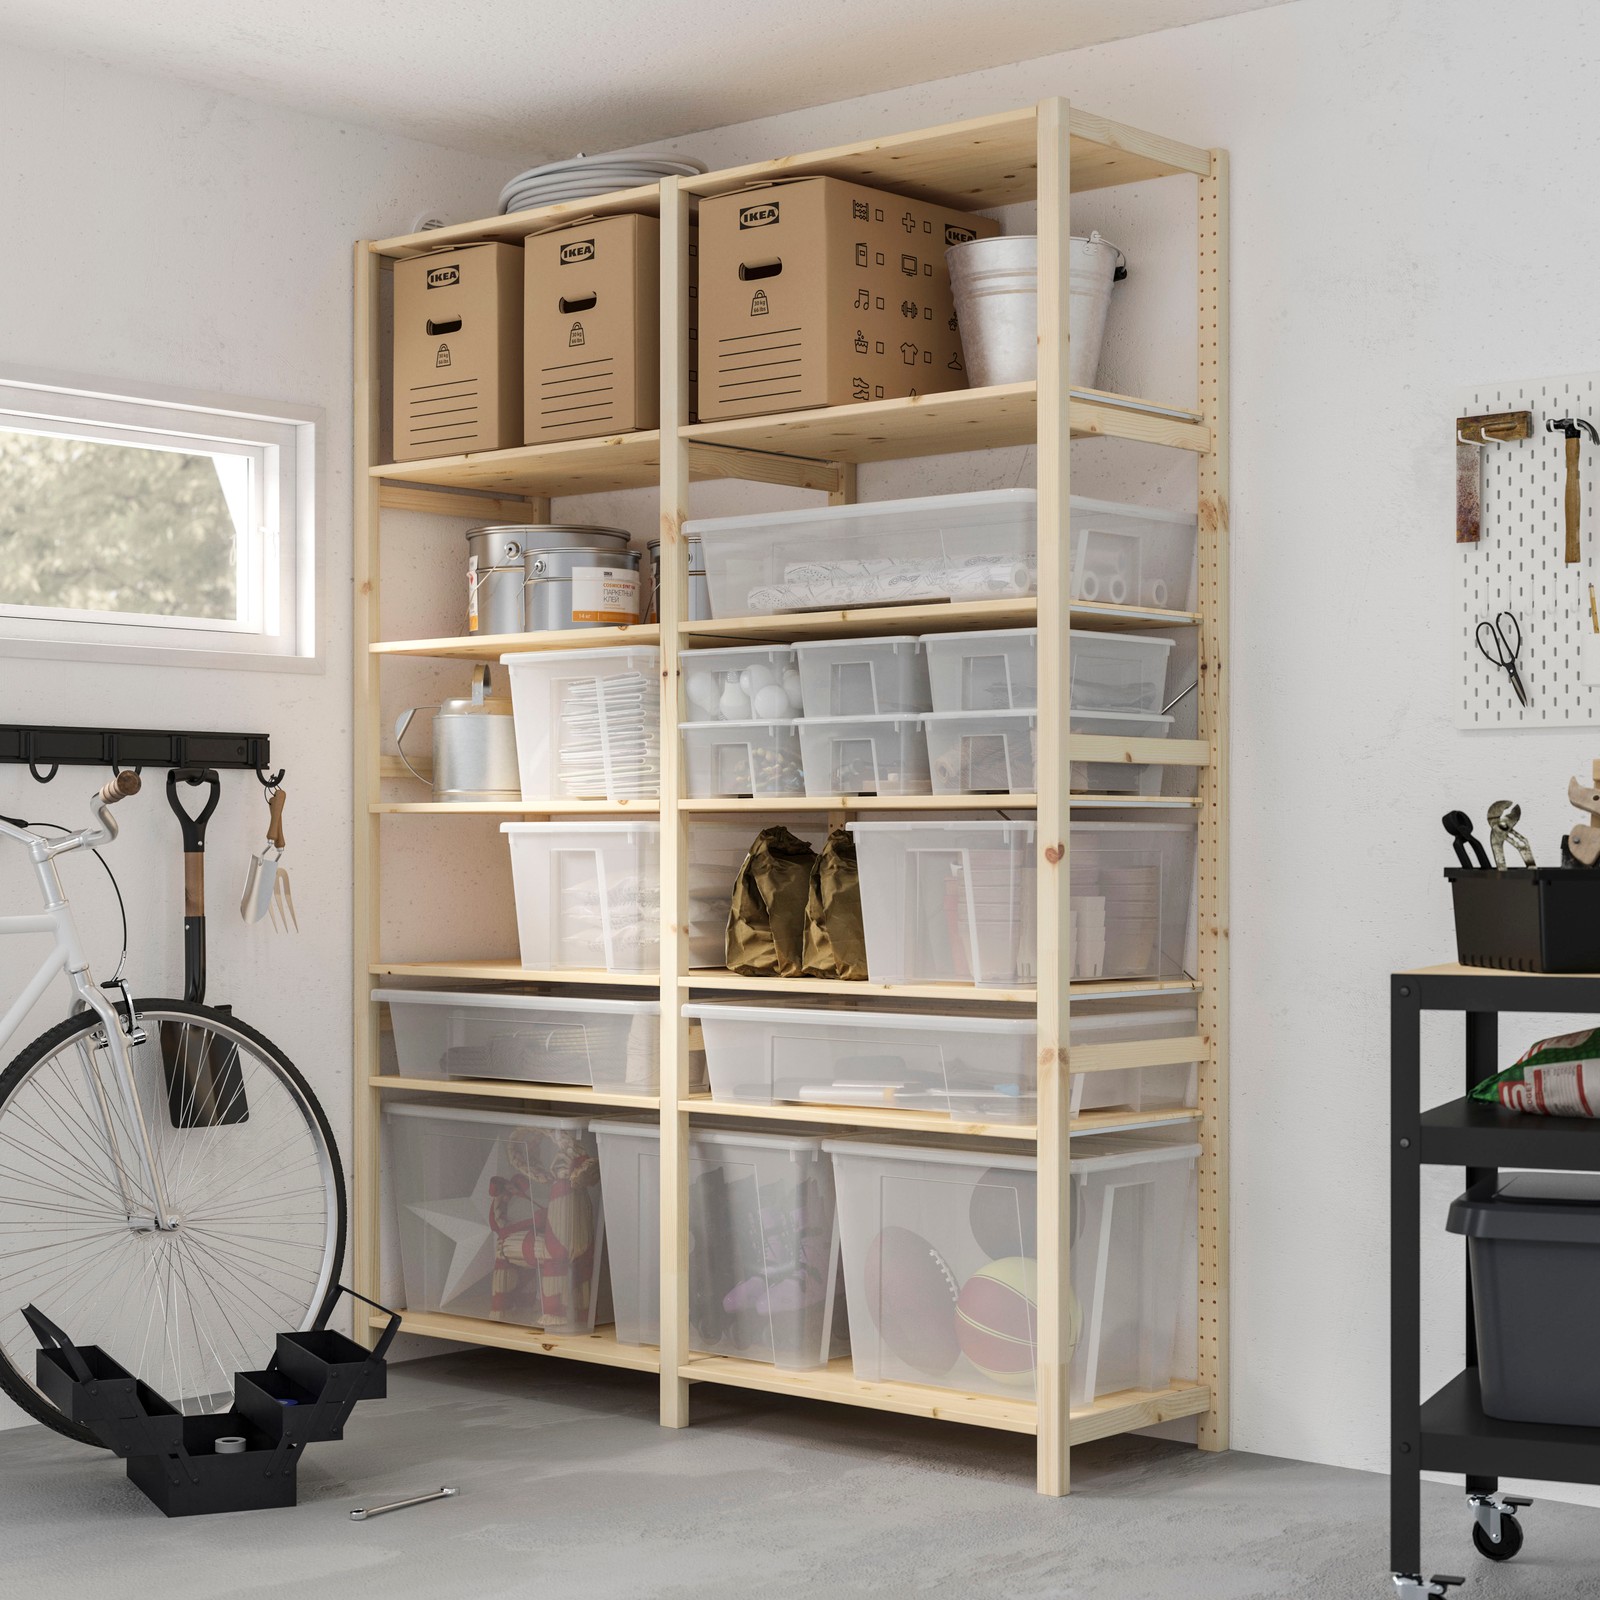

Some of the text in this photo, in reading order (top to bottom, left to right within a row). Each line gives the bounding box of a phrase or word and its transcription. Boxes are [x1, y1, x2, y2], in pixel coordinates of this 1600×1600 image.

[744, 209, 776, 222] IKEA
[564, 246, 592, 258] IKEA
[430, 271, 457, 283] IKEA
